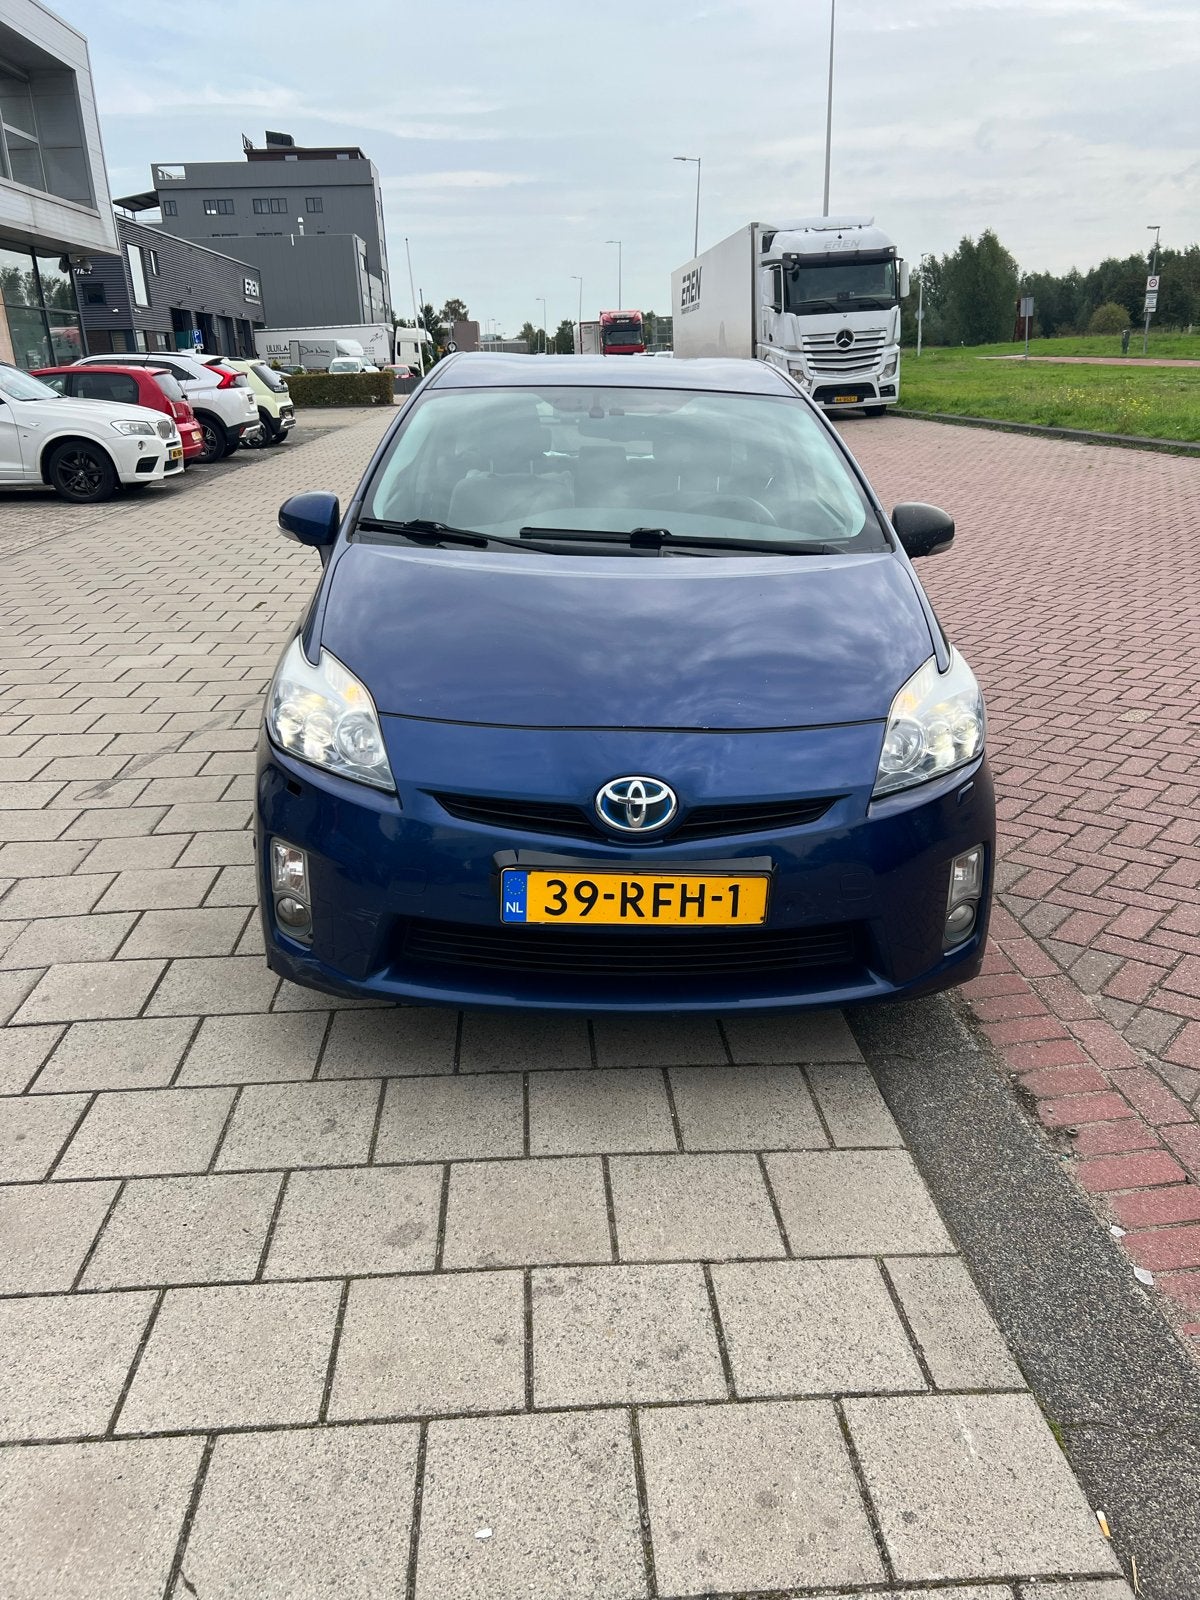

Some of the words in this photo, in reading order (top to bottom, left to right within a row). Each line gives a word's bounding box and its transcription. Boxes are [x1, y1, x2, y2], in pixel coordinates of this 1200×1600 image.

[824, 240, 861, 249] EREN
[681, 266, 702, 306] EREN
[505, 901, 524, 914] NL
[544, 879, 740, 918] 39-RFH-1
